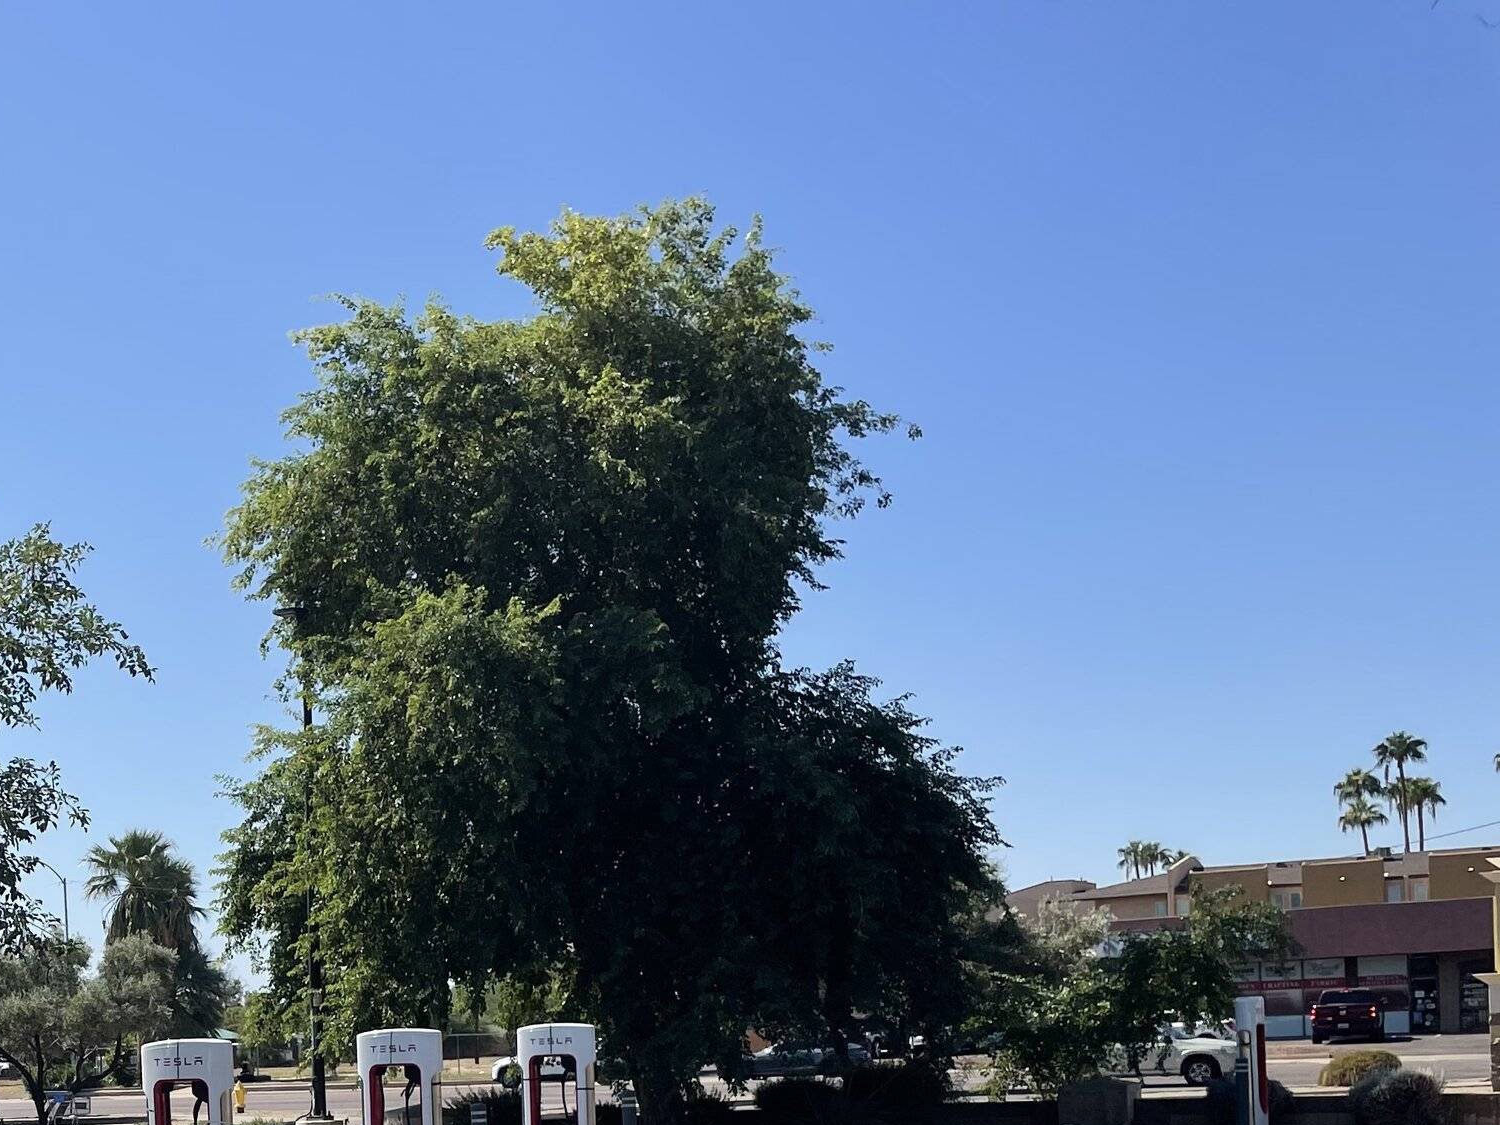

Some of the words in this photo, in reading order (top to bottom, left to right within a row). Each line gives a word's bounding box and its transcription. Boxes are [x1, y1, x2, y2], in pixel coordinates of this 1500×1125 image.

[530, 1036, 573, 1046] TESLA
[370, 1044, 417, 1054] TESLA
[153, 1056, 203, 1067] TESLA
